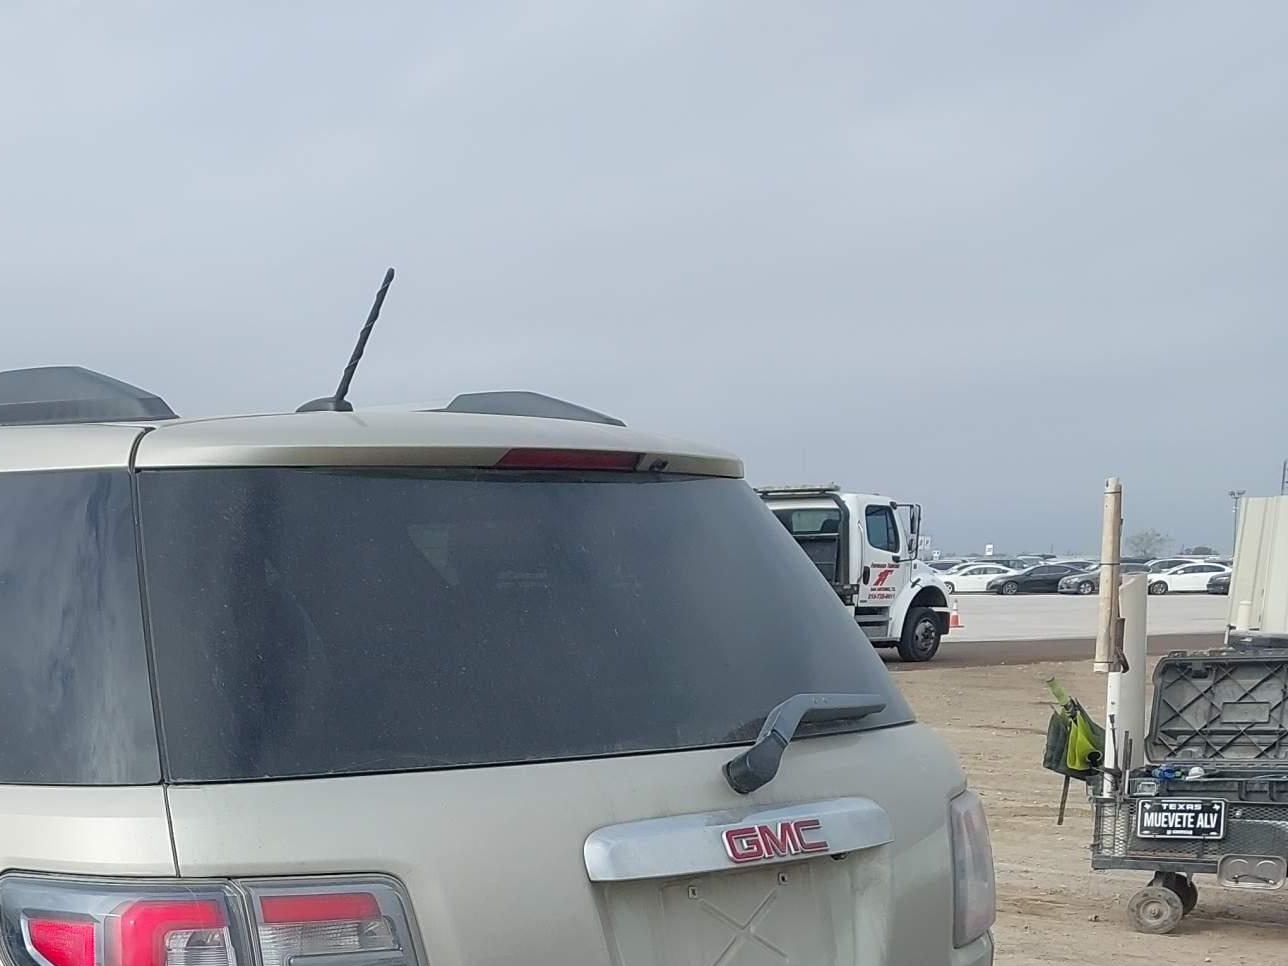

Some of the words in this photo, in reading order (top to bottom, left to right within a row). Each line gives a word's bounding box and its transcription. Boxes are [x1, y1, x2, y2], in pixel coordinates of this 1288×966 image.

[1143, 812, 1195, 827] MUEVETE
[1196, 812, 1217, 828] ALV
[722, 818, 830, 863] GMC
